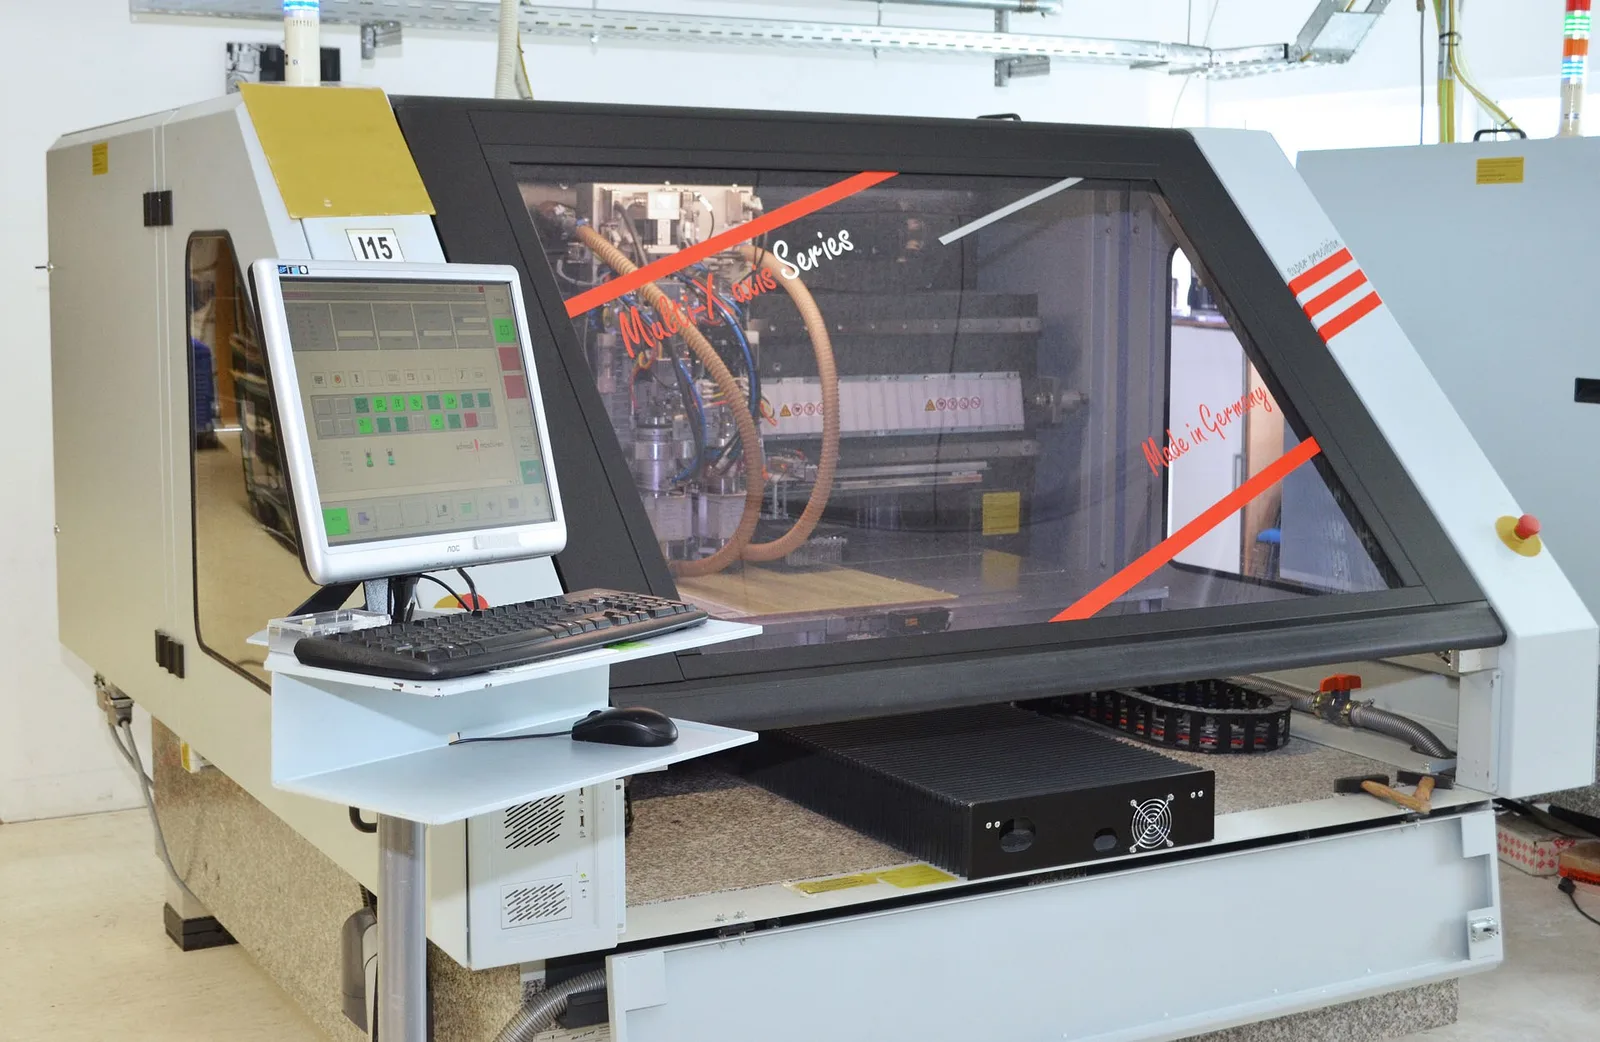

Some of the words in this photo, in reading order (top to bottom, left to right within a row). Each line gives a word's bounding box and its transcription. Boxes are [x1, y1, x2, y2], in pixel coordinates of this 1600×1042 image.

[772, 229, 855, 281] Series
[1141, 429, 1190, 477] Made
[1185, 422, 1209, 446] in
[1198, 386, 1273, 441] Germany
